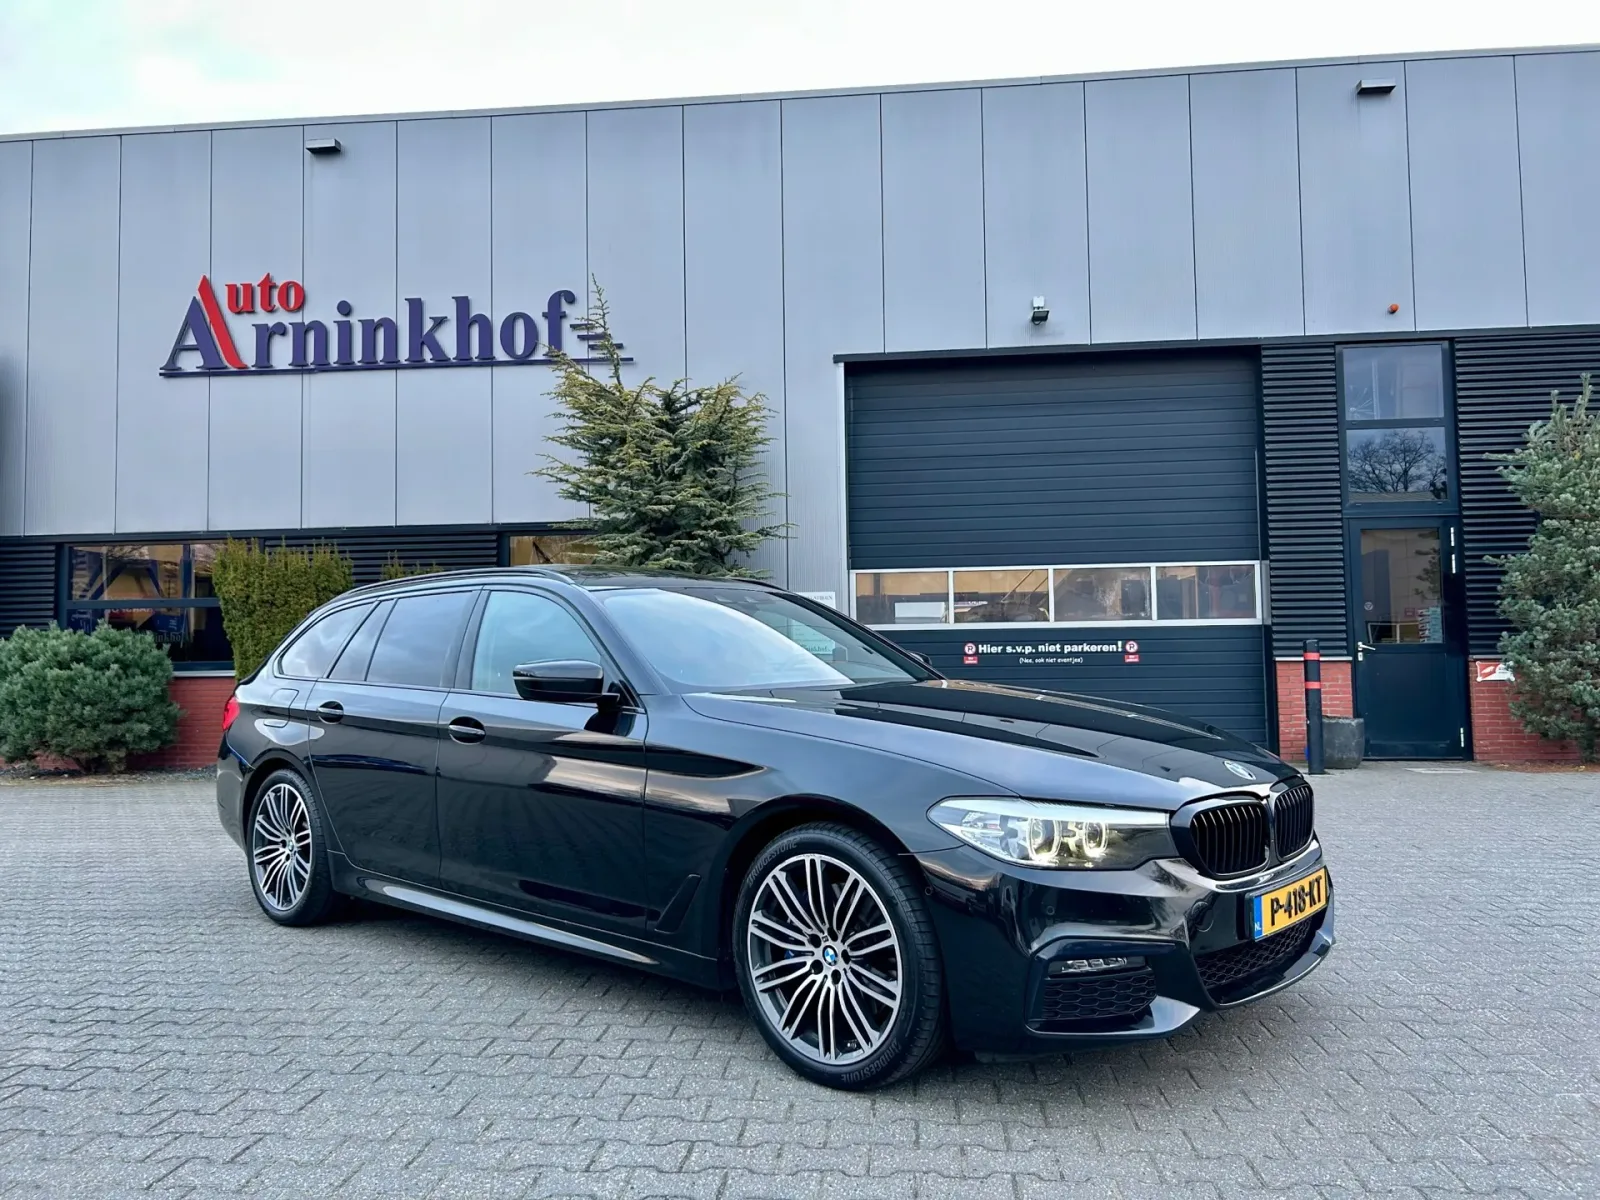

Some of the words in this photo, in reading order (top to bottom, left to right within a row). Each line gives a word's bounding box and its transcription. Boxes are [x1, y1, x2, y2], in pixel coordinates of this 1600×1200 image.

[159, 274, 577, 370] Arninkhof
[978, 644, 1003, 654] Hier
[1005, 644, 1036, 655] s.v.p.
[1038, 642, 1061, 653] niet
[1063, 641, 1123, 654] parkeren!
[1270, 874, 1322, 927] P-418-KT
[1254, 921, 1262, 931] NL
